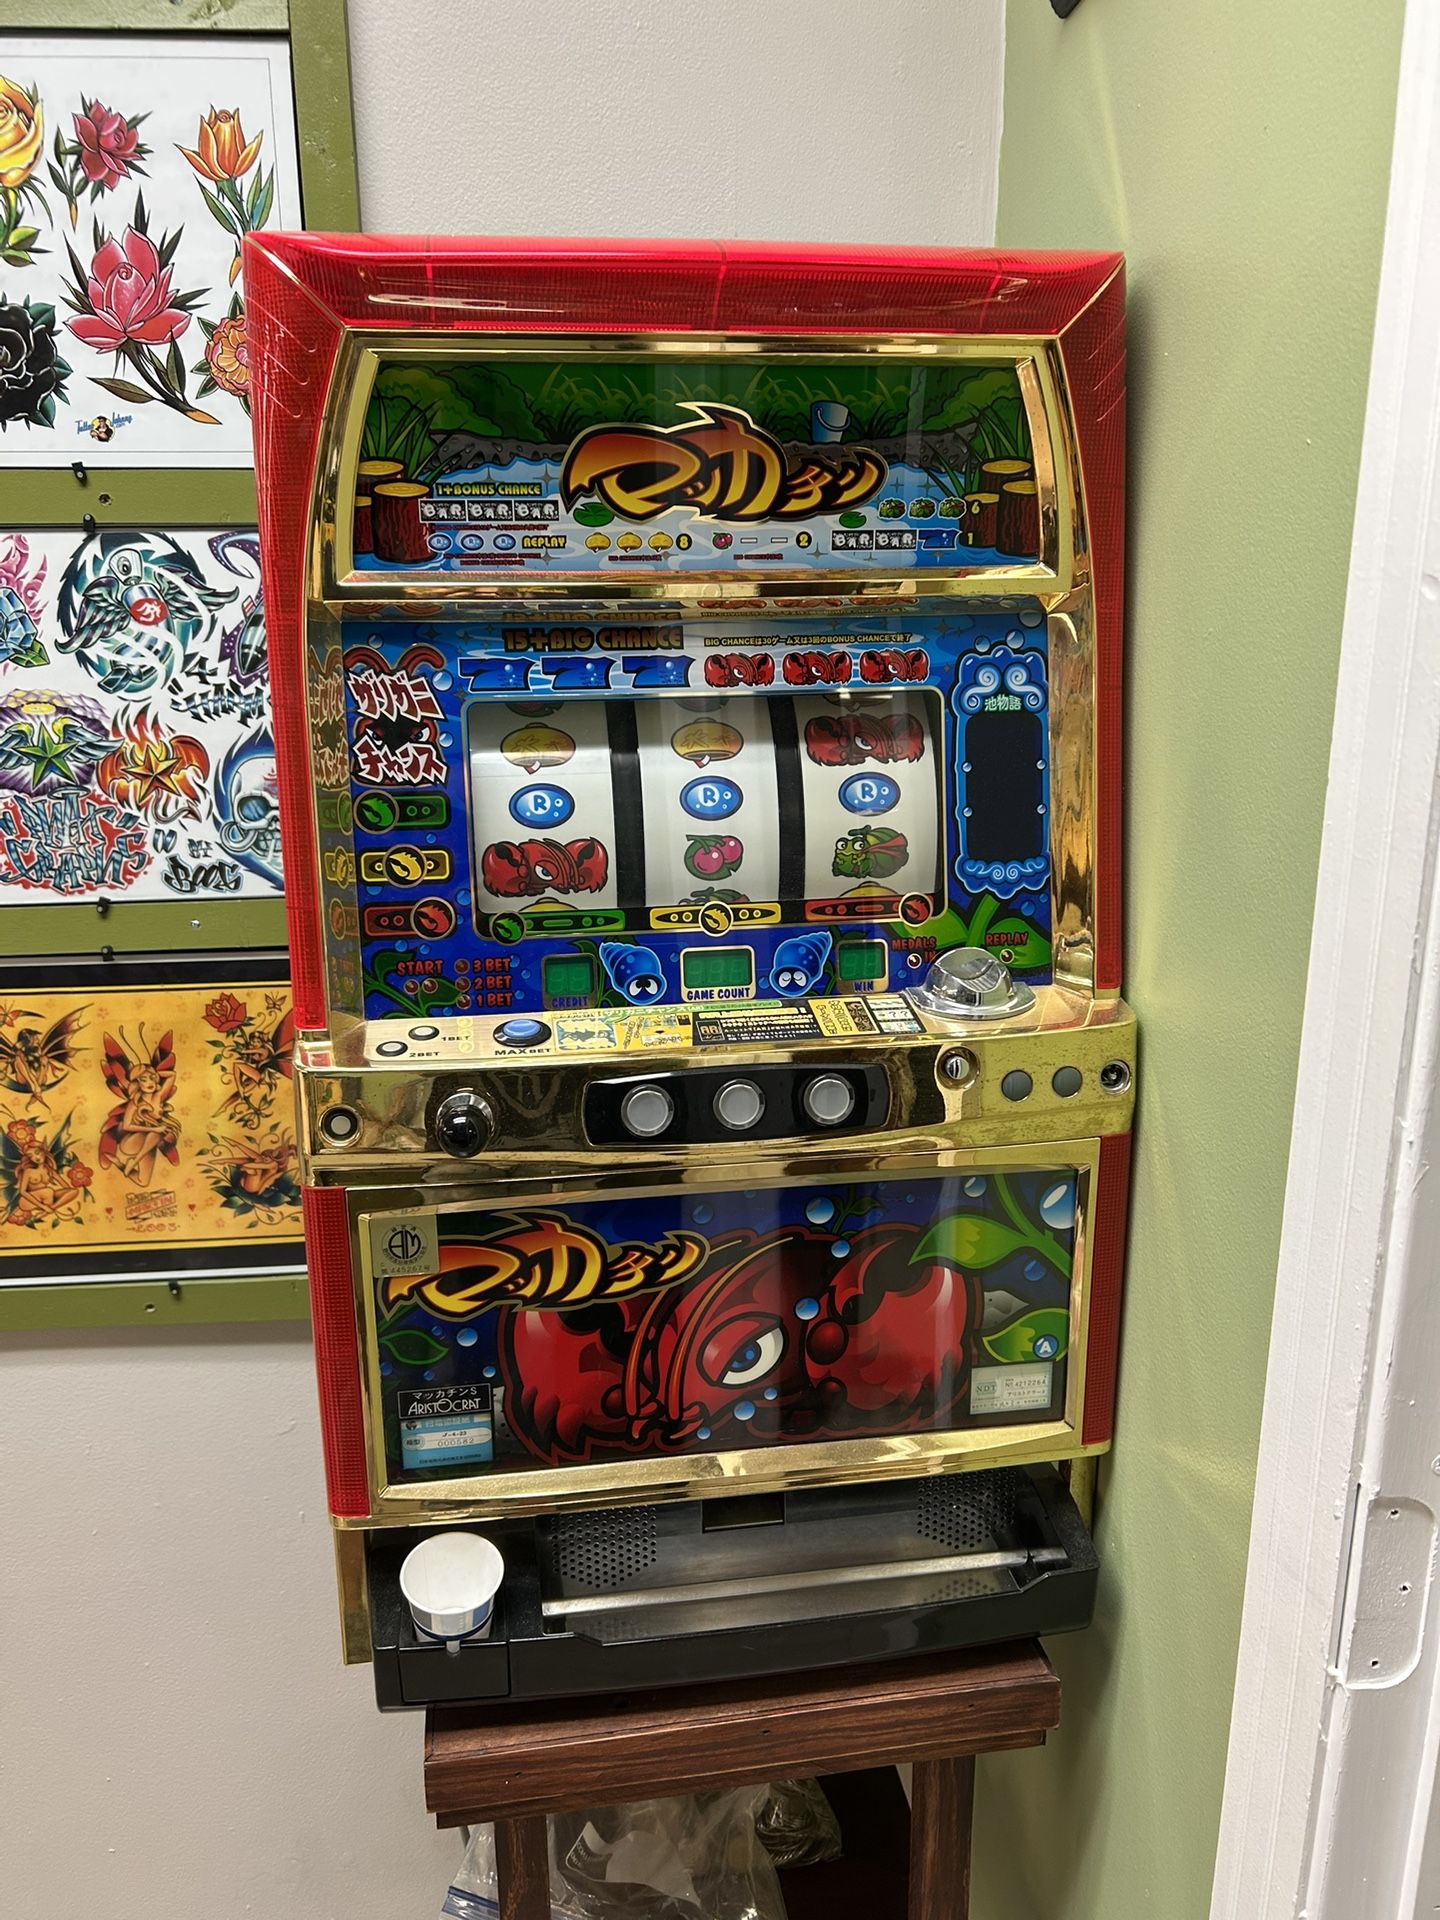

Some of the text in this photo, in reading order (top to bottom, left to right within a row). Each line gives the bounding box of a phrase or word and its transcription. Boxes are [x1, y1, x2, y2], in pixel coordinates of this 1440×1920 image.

[437, 484, 541, 496] 1+BONUS CHANCE
[971, 501, 980, 514] 6
[523, 536, 566, 548] REPLAY
[679, 536, 689, 549] 8
[798, 534, 808, 547] 2
[967, 532, 975, 545] 1
[503, 626, 684, 652] 15+BIG CHANCE
[704, 637, 720, 647] BIG
[348, 668, 448, 722] ザリガニ
[984, 695, 1022, 712] 池物語
[353, 735, 449, 785] チャンス
[892, 936, 937, 950] MEDALS
[985, 932, 1029, 946] REPLAY
[396, 959, 444, 976] START
[473, 958, 511, 972] 3 BET
[473, 976, 511, 991] 2 BET
[853, 981, 874, 992] WIN
[476, 993, 513, 1007] 1 BET
[686, 985, 750, 1001] GAME COUNT
[551, 996, 589, 1008] CREDIT
[408, 1398, 481, 1415] ARISTOCRAT
